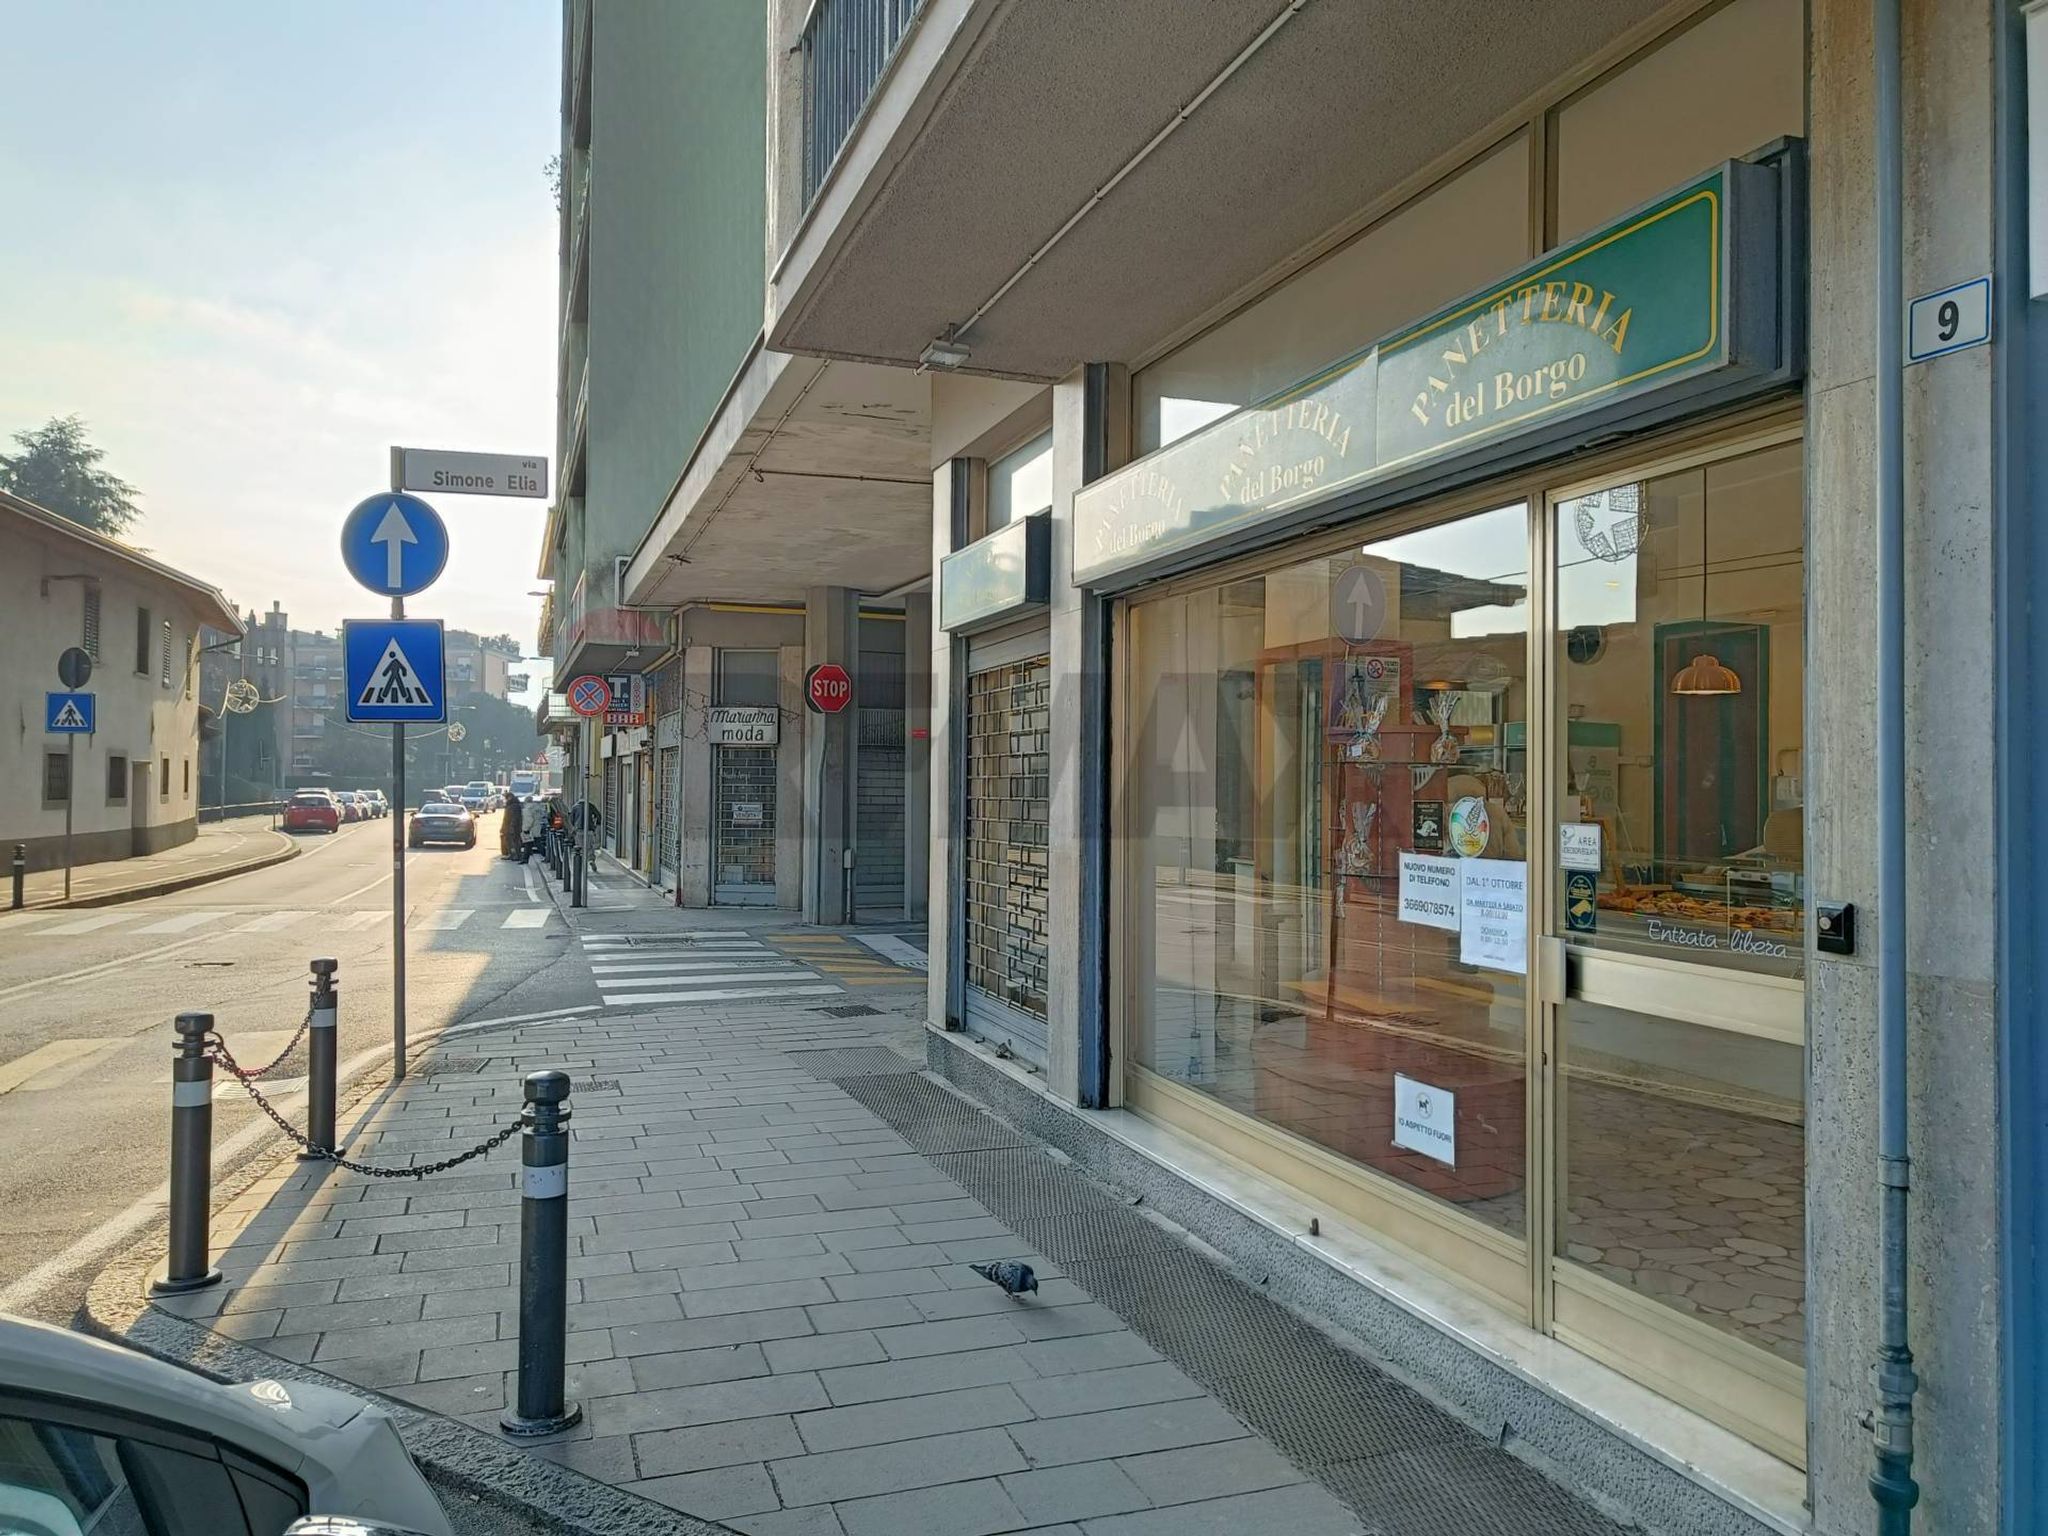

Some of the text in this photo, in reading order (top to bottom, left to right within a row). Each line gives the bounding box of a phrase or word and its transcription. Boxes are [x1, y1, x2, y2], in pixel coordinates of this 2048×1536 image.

[1938, 301, 1959, 341] 9
[1411, 281, 1632, 427] PANETTERIA
[1446, 353, 1586, 427] del Borgo
[1220, 399, 1351, 501] PANETTERIA
[522, 460, 537, 469] via
[433, 471, 537, 491] Simone Elia
[1240, 456, 1324, 504] del Borgo
[813, 679, 848, 698] STOP
[607, 712, 639, 724] BAR
[711, 709, 776, 725] Marianna
[722, 725, 764, 741] moda
[1578, 836, 1597, 847] AREA
[1403, 862, 1456, 876] NUOVO NUMERO
[1409, 874, 1450, 888] DI TELEFONO
[1466, 876, 1481, 887] DAL
[1491, 878, 1523, 891] OTTOBRE
[1404, 898, 1455, 917] 3669078574
[1647, 919, 1788, 958] Entrata libera
[1405, 1119, 1433, 1136] ASPETTO
[1432, 1130, 1453, 1144] FUORI
